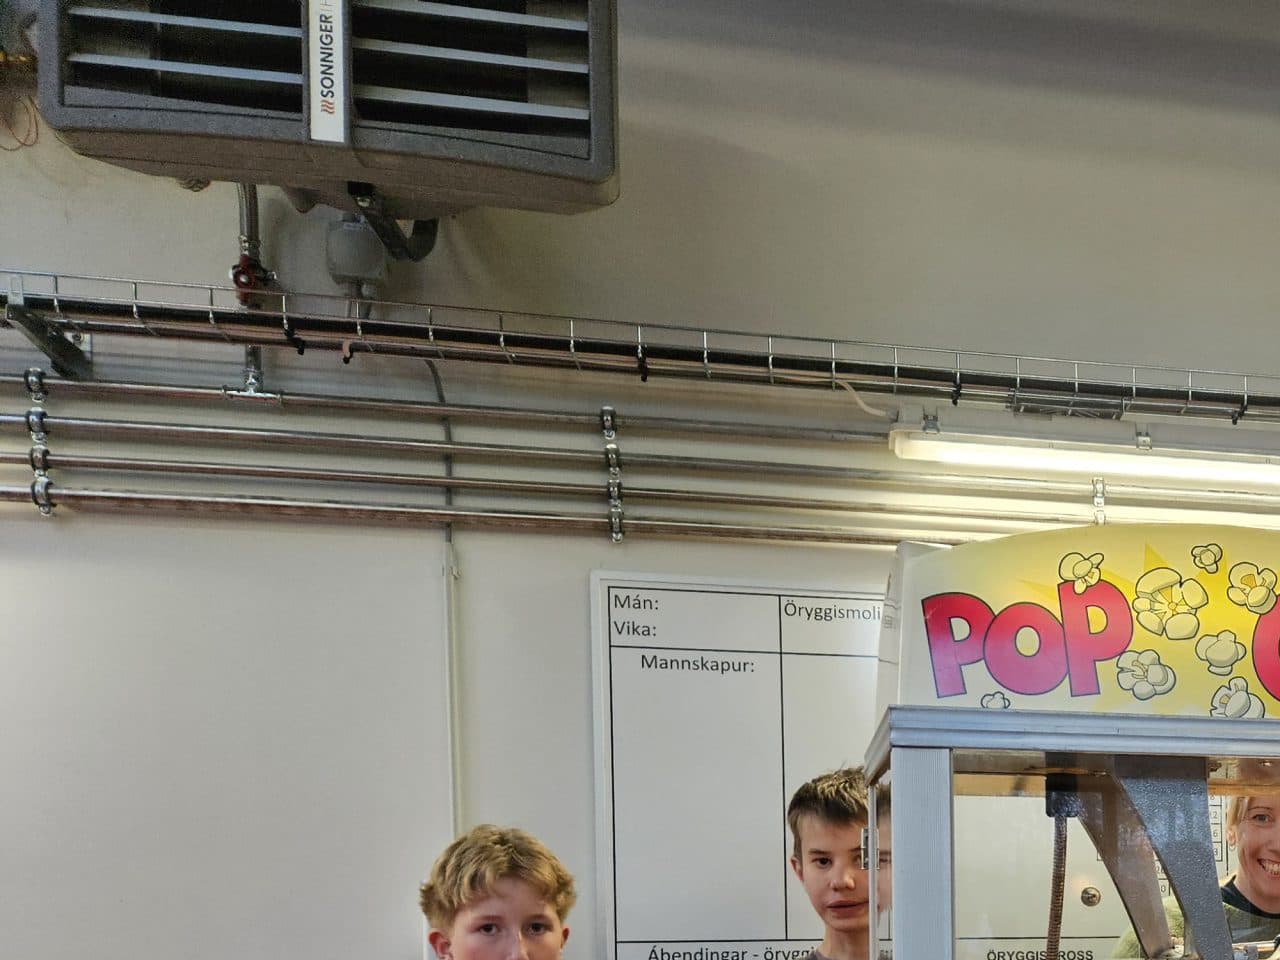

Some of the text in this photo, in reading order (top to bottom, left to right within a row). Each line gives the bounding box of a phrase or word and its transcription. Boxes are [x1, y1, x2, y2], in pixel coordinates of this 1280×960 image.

[319, 13, 335, 99] SONNIGER
[613, 593, 659, 611] Mán:
[613, 620, 658, 637] Vika:
[921, 578, 1134, 698] POP
[641, 654, 755, 675] Mannskapur:
